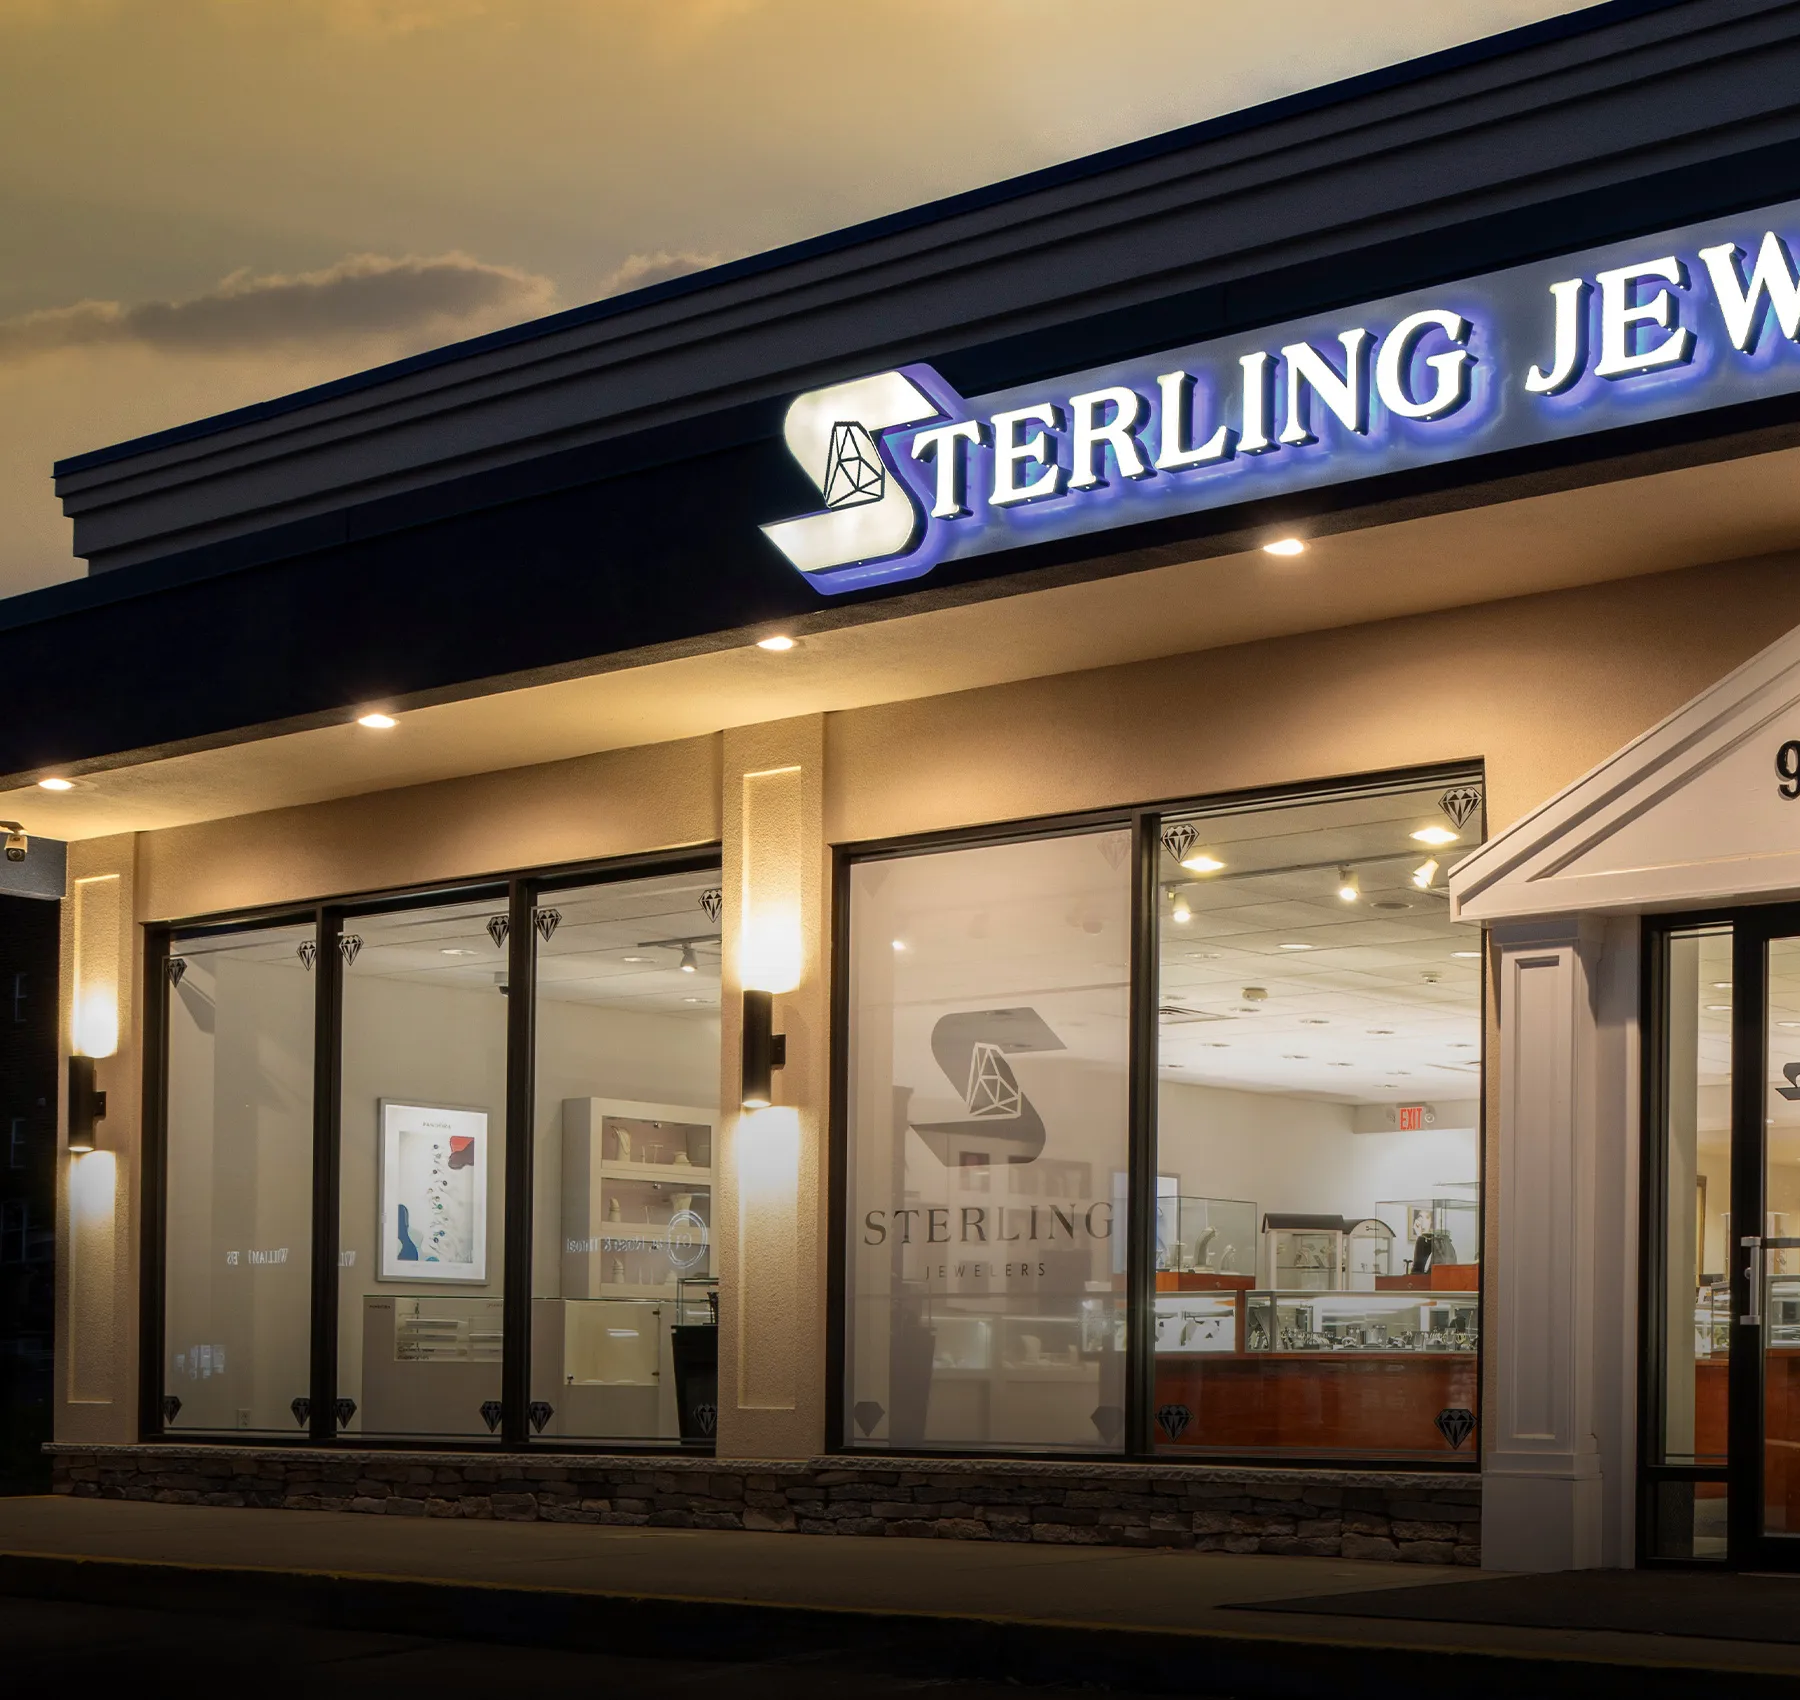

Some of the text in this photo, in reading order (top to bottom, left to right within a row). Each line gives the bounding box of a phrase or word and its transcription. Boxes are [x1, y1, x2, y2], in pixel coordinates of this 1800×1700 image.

[758, 308, 1478, 572] STERLING
[1400, 1107, 1423, 1130] EXIT
[863, 1202, 1114, 1246] STERLING
[926, 1263, 1046, 1280] JEWELERS
